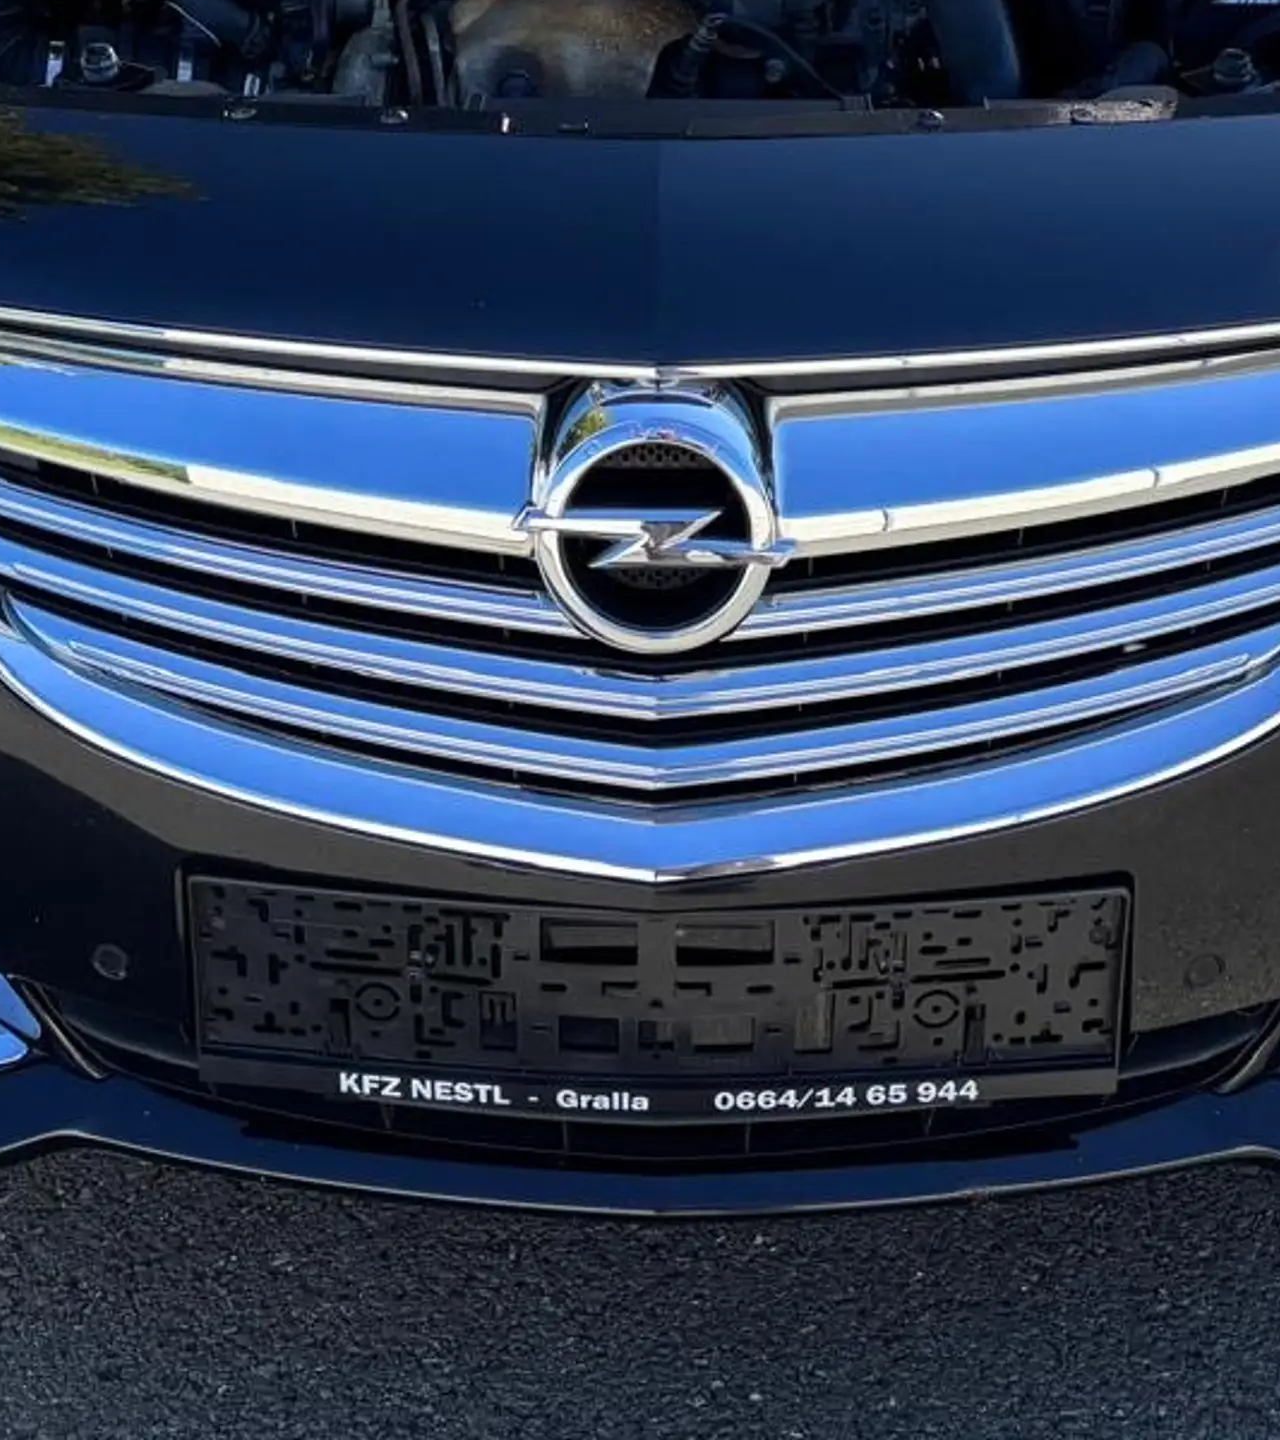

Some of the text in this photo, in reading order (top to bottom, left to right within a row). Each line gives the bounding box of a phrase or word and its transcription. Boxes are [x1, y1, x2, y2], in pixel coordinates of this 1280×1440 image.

[339, 1071, 402, 1098] KFZ
[410, 1078, 511, 1106] NESTL
[555, 1088, 650, 1111] Gralla
[713, 1085, 857, 1111] 0664/14
[865, 1082, 908, 1106] 65
[916, 1078, 980, 1103] 944
